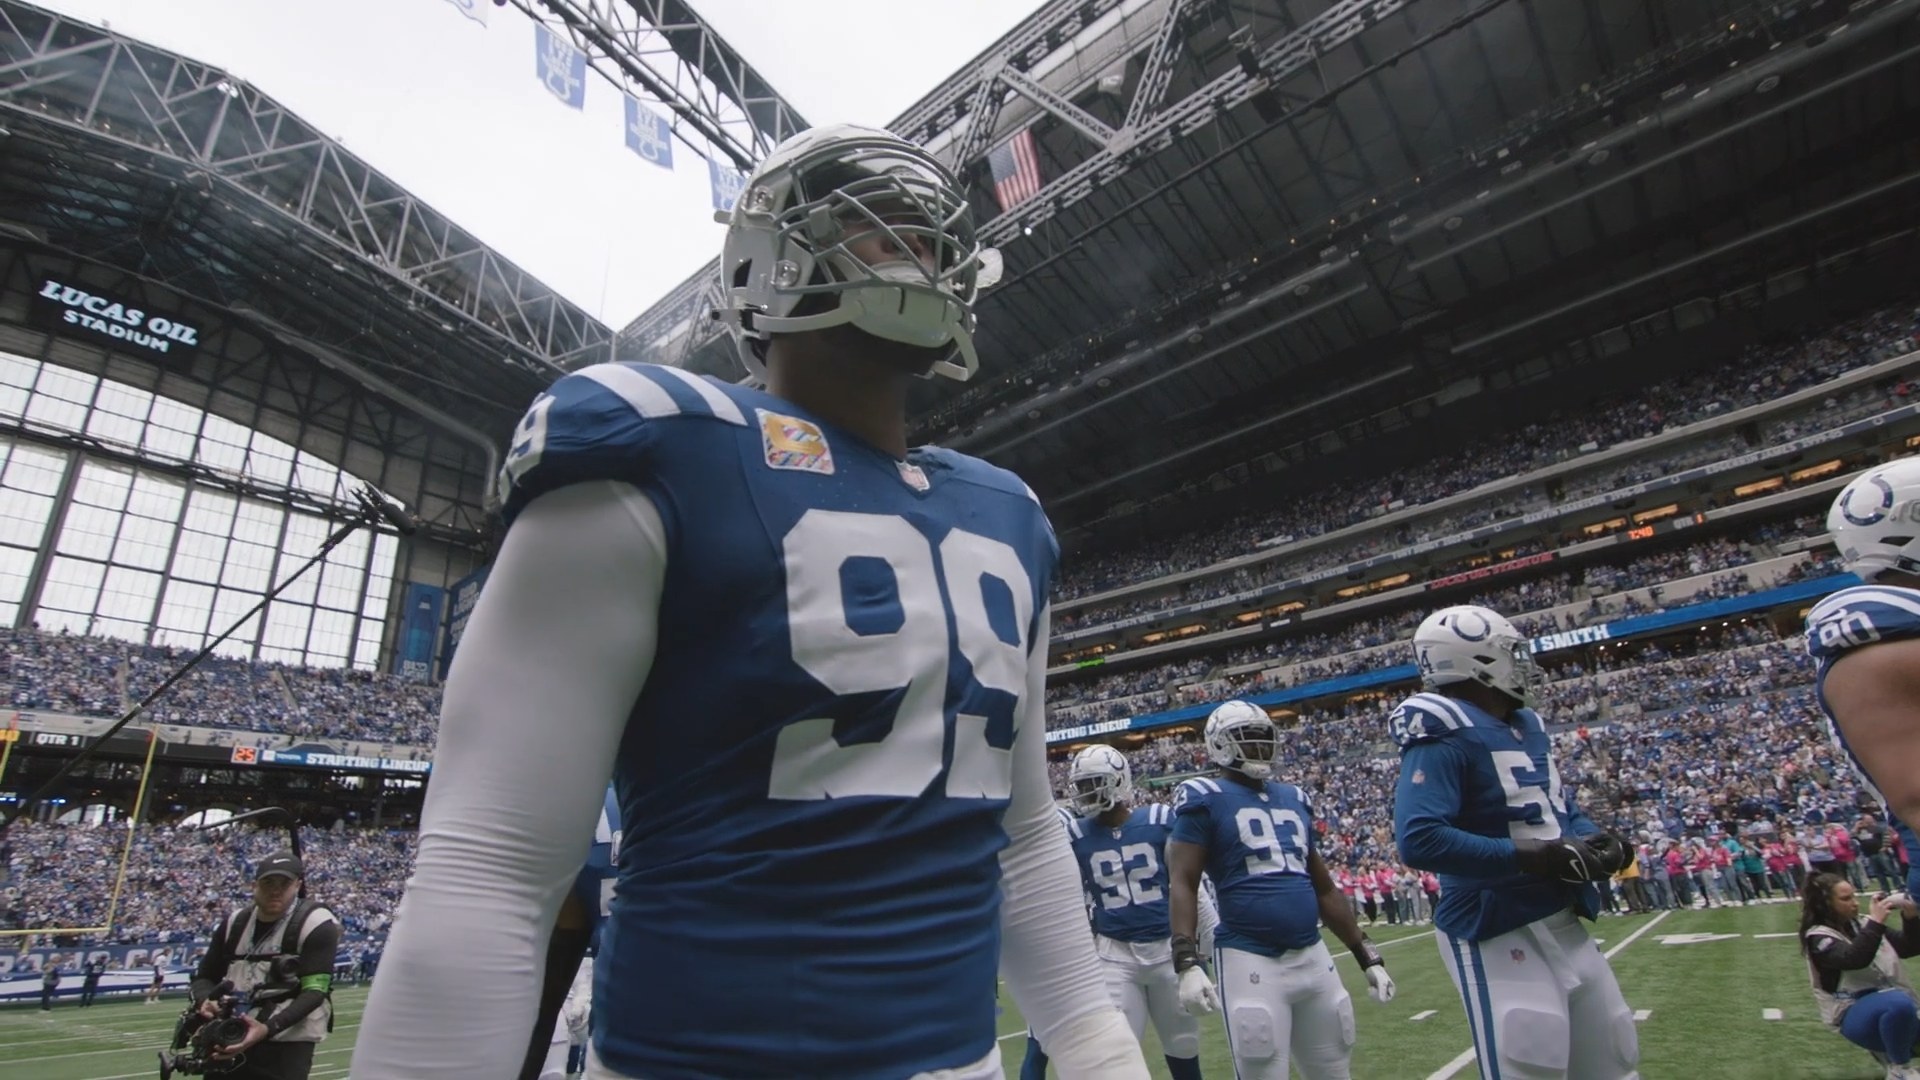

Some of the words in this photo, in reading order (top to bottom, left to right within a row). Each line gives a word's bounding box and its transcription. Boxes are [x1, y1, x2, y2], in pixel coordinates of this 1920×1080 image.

[39, 280, 145, 327] LUCAS
[147, 316, 198, 346] OIL
[63, 309, 170, 353] STADIUM
[768, 508, 1034, 800] 99
[1540, 624, 1610, 652] SMITH
[36, 733, 68, 746] QTR
[71, 735, 79, 746] 1
[1088, 718, 1131, 735] LINEUP
[306, 753, 379, 769] STARTING
[381, 758, 430, 773] LINEUP
[1235, 808, 1309, 875] 93
[1089, 841, 1163, 911] 92
